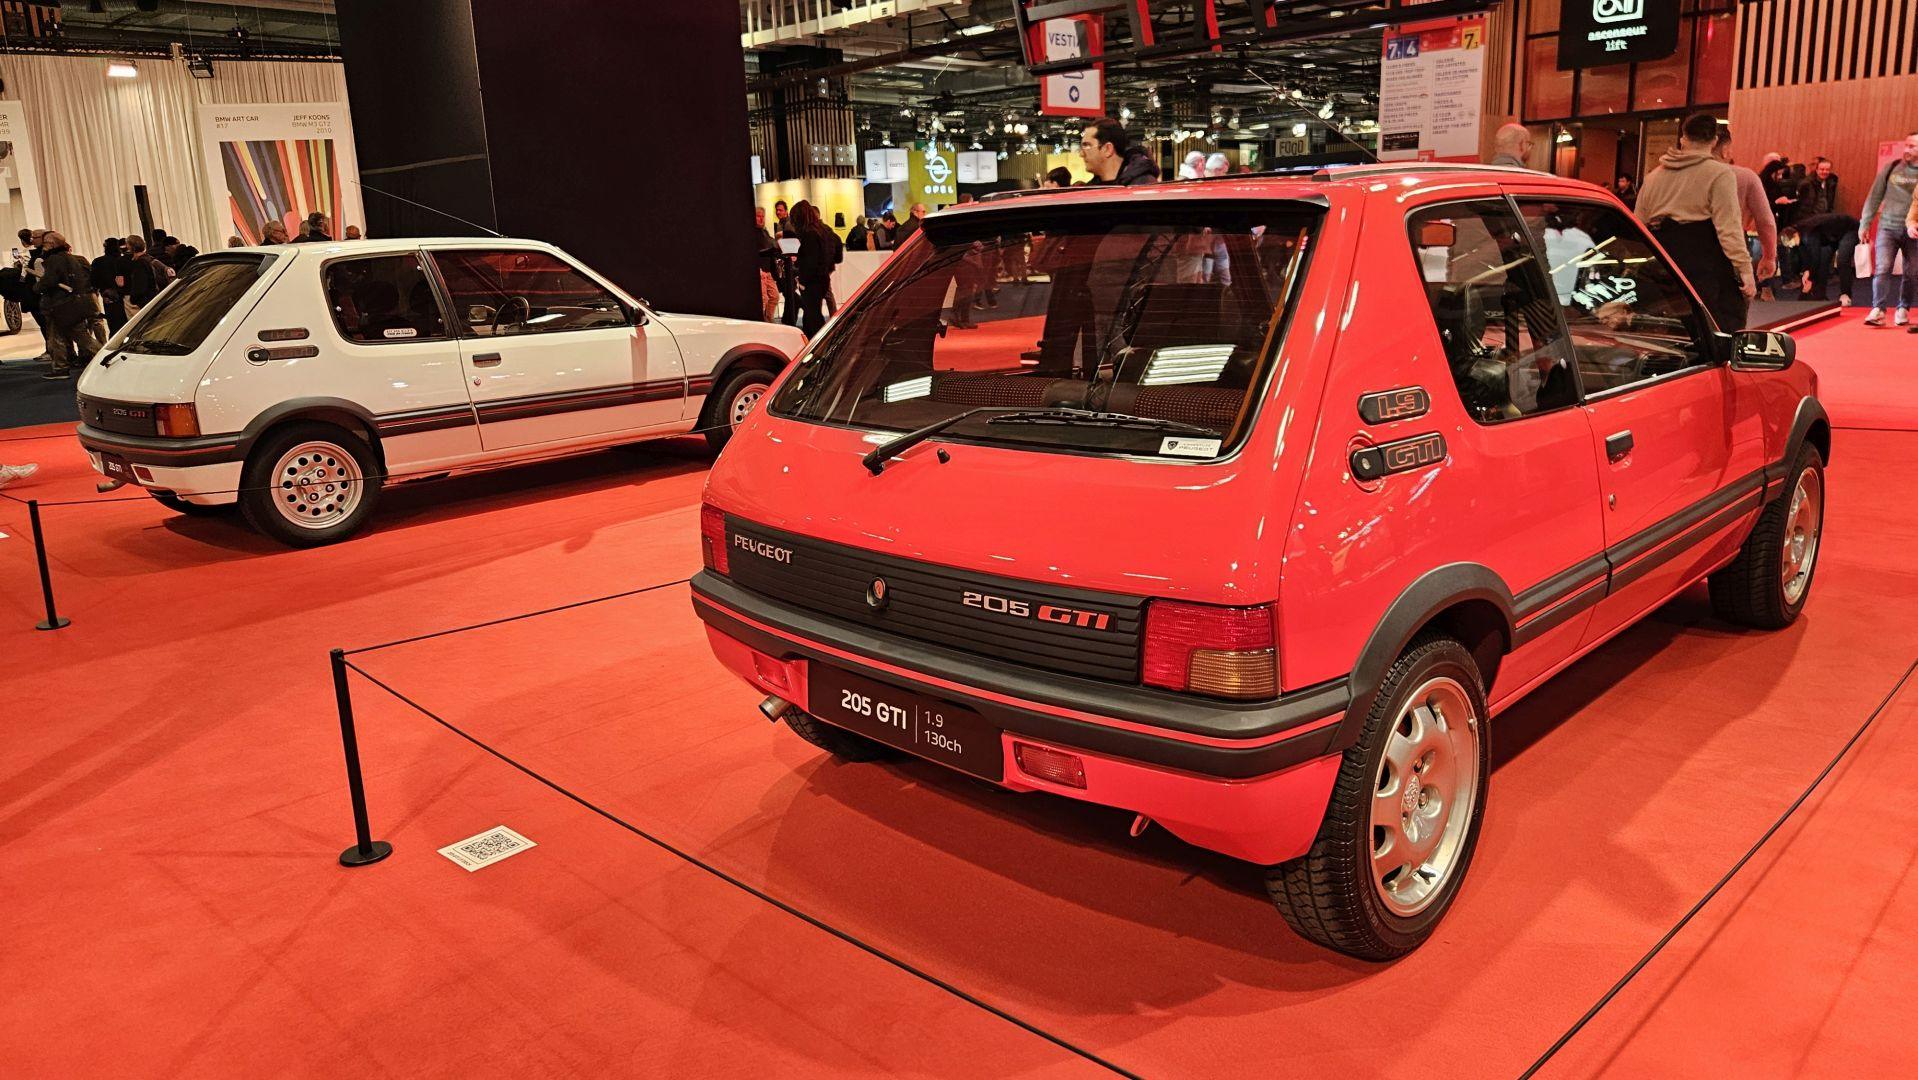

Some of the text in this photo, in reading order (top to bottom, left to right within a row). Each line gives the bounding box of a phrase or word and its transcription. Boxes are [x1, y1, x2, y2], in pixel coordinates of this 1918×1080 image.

[1048, 32, 1080, 47] VESTI
[1588, 25, 1648, 41] ascenseur
[1605, 40, 1627, 52] lift
[924, 185, 954, 194] OPEL
[1386, 437, 1441, 469] GTI
[734, 534, 793, 563] PEUGEOT
[963, 591, 1109, 630] 205 GTI
[841, 689, 907, 729] 205 GTI
[924, 711, 944, 728] 1.9
[924, 730, 962, 754] 130ch
